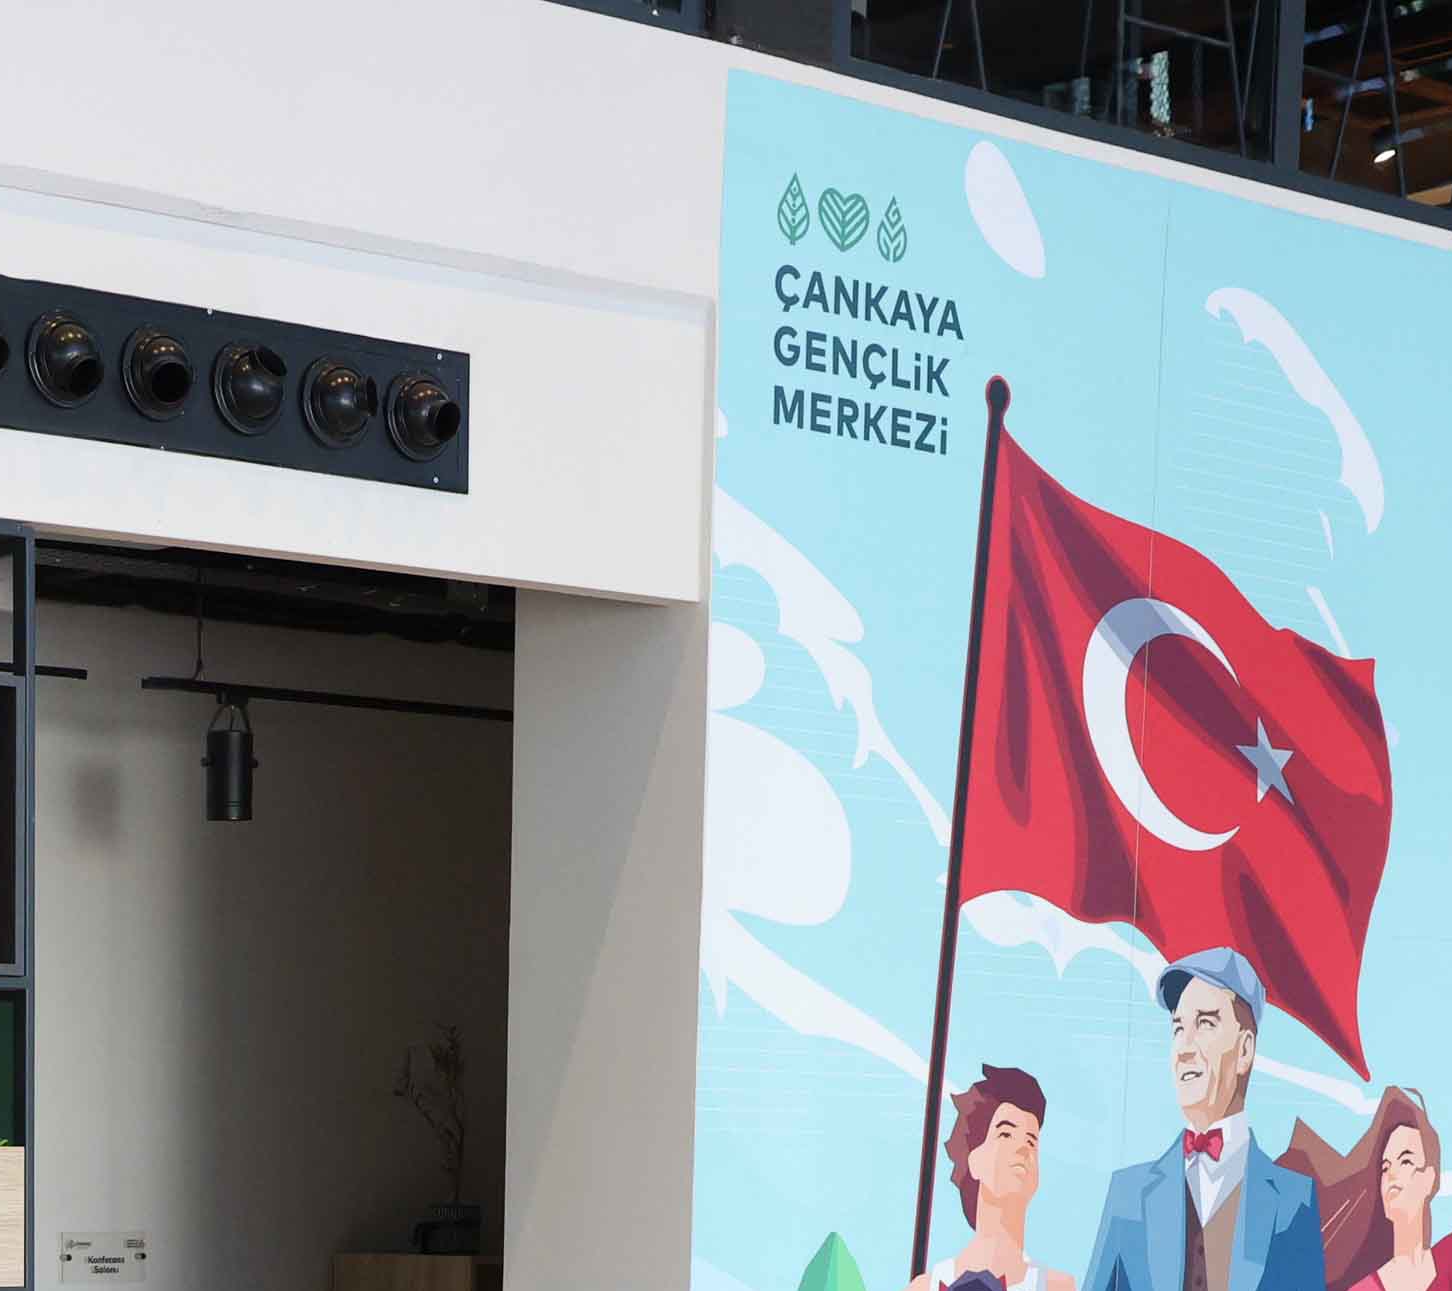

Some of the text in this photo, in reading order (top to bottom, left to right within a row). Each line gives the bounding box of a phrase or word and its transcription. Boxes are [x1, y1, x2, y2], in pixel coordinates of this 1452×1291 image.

[775, 264, 964, 340] ÇANKAYA
[774, 326, 950, 397] GENÇLİK
[773, 385, 948, 455] MERKEZİ
